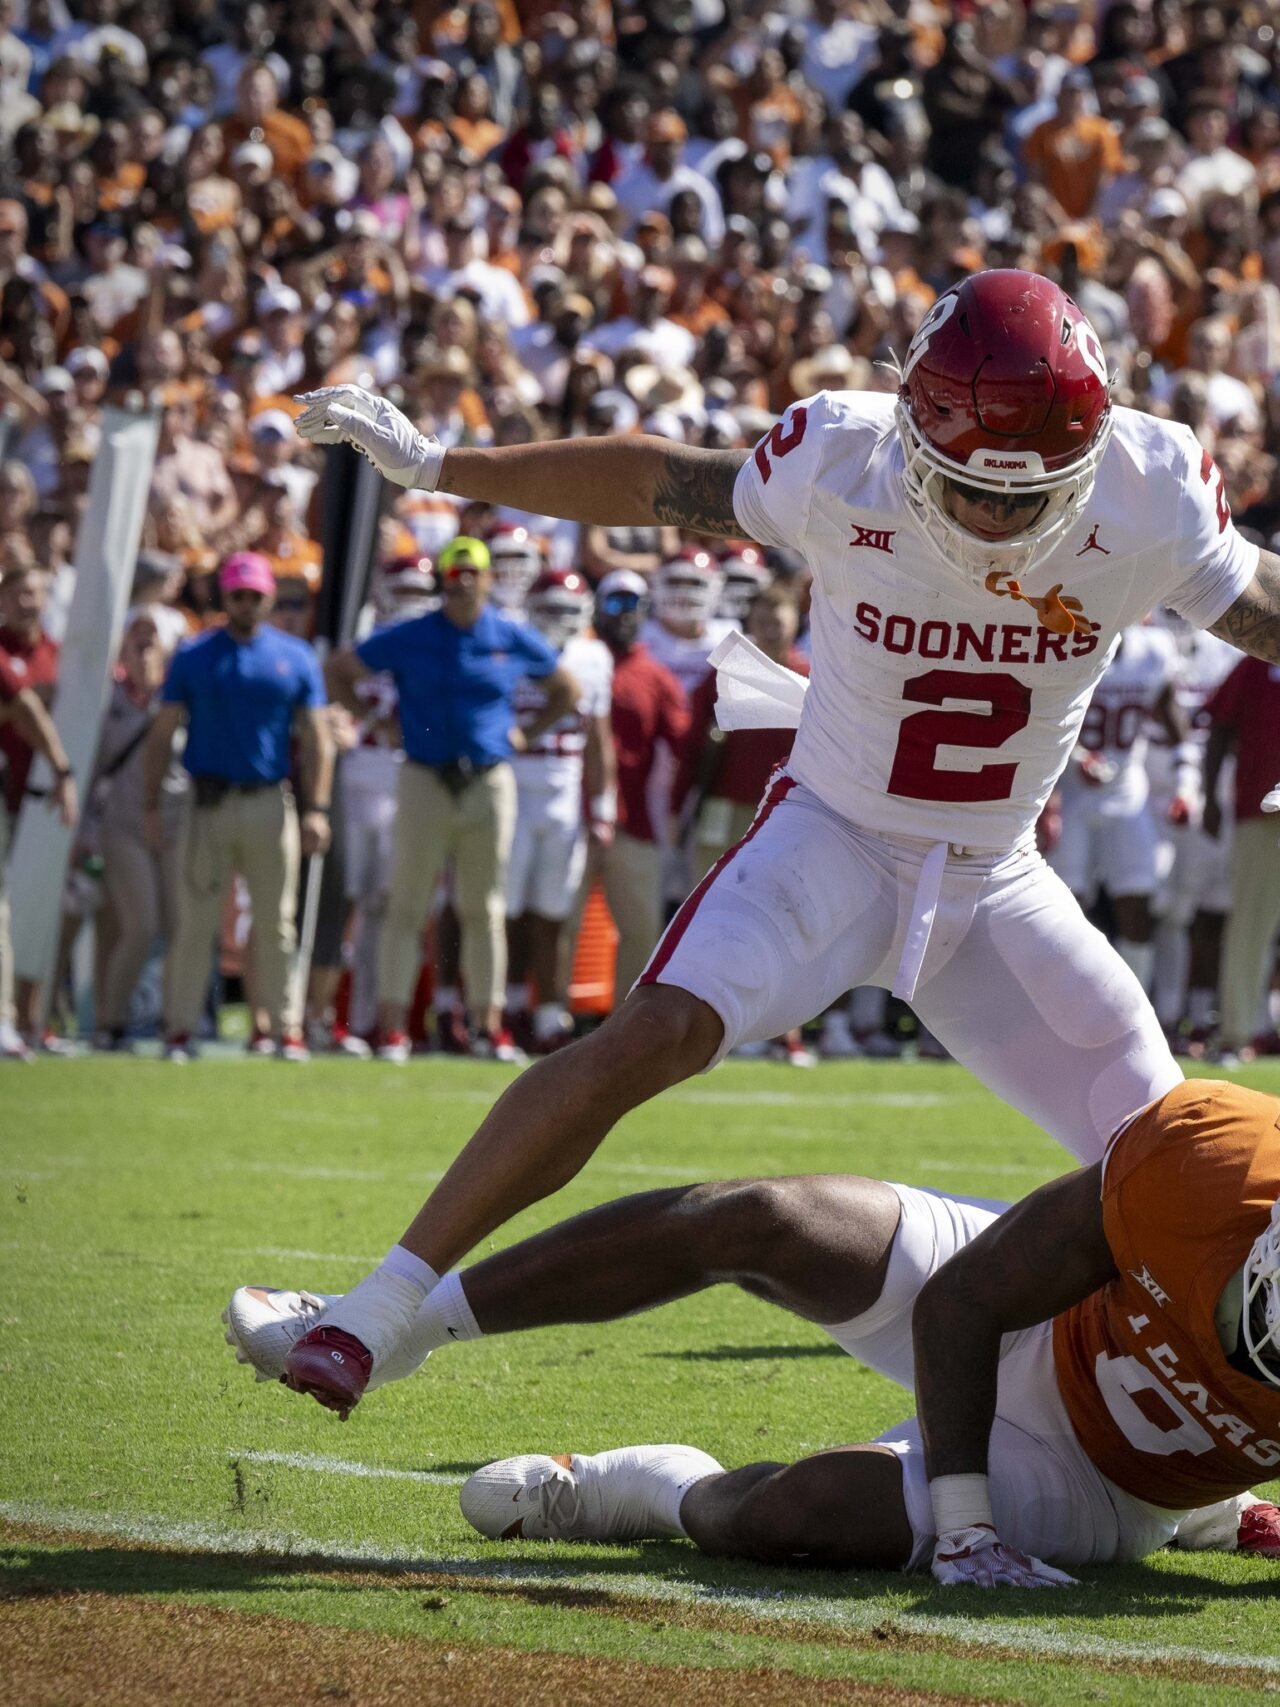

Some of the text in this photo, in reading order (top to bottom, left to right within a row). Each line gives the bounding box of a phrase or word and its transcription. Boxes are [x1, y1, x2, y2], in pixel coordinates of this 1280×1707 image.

[755, 407, 808, 485] 2
[983, 457, 1028, 470] OKLAHOMA
[849, 523, 897, 555] XII
[853, 601, 1102, 664] SOONERS
[886, 668, 1033, 803] 2
